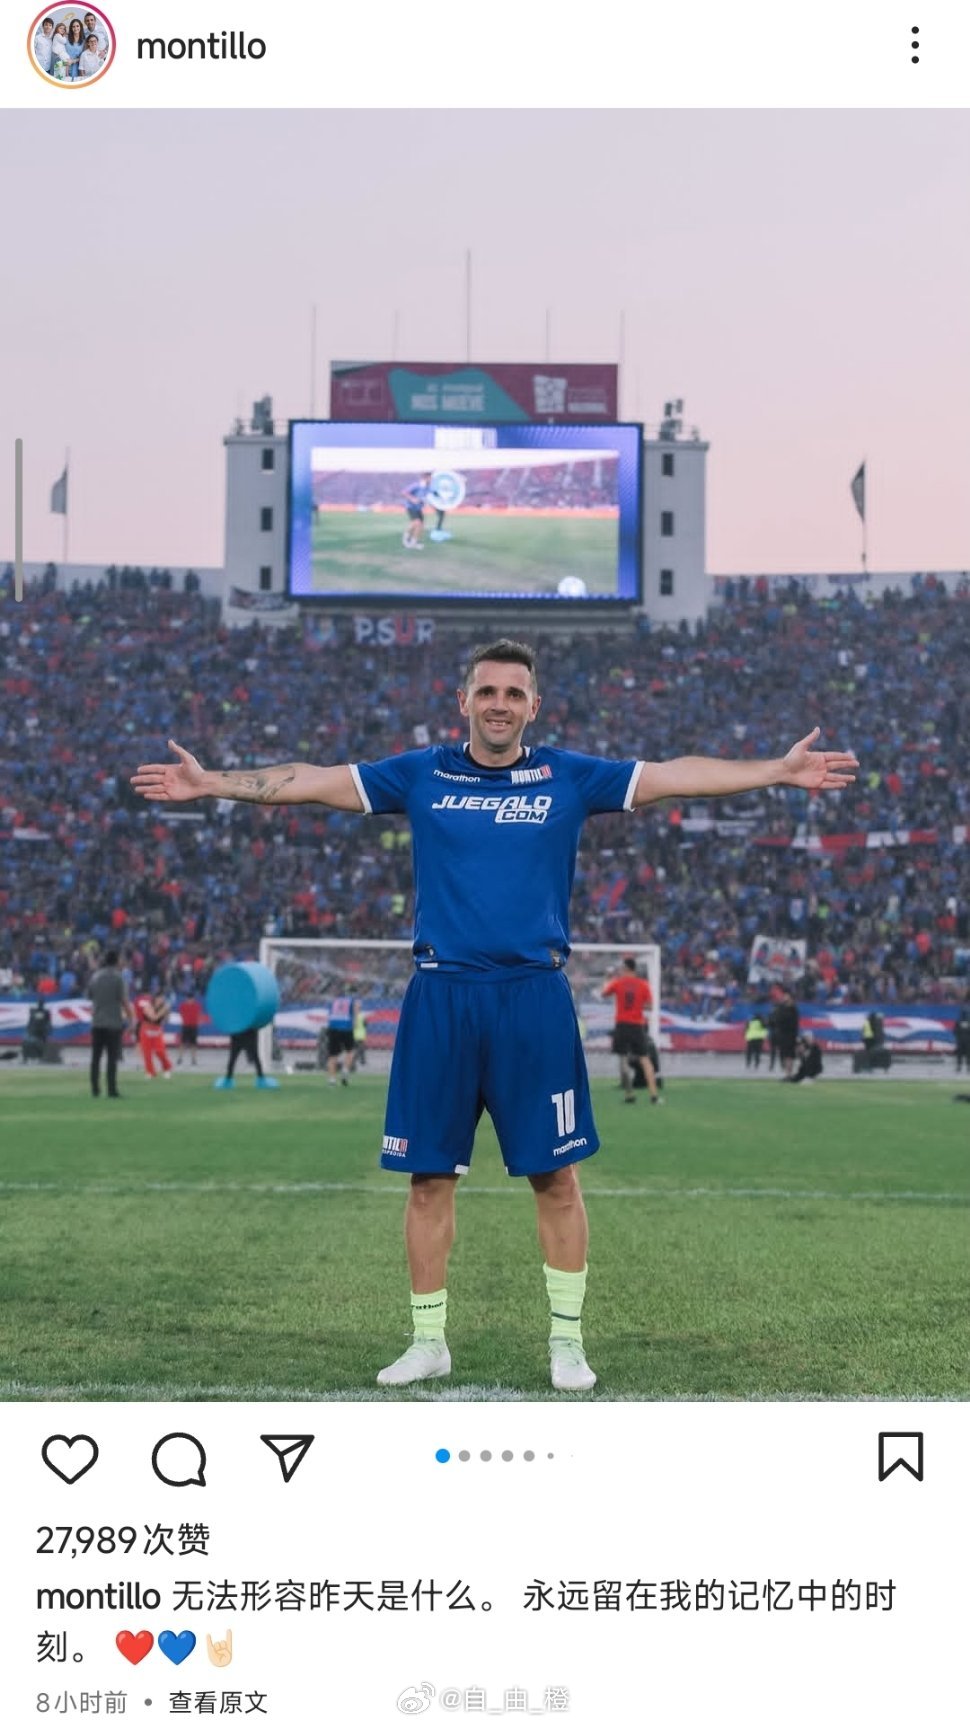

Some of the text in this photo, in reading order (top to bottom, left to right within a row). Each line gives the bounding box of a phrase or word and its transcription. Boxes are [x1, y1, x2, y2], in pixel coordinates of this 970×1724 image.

[433, 769, 481, 783] marathon
[431, 795, 552, 810] JUEGALO
[551, 1089, 576, 1138] 10
